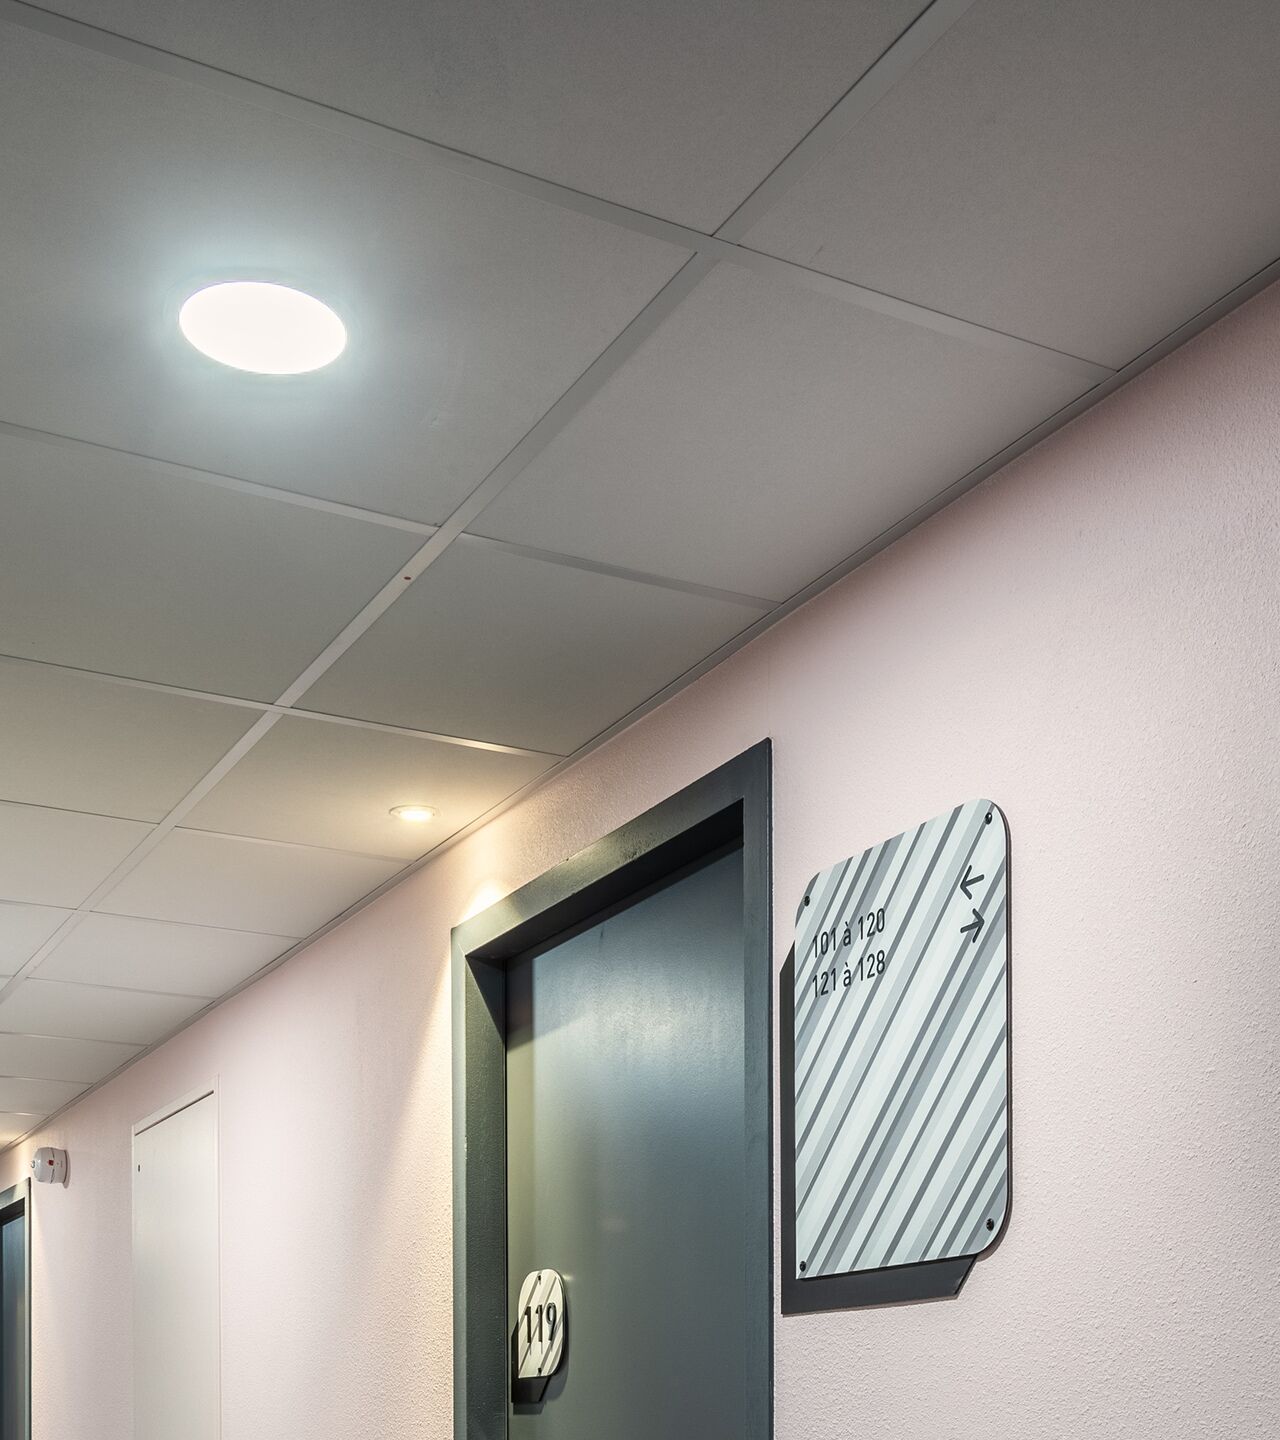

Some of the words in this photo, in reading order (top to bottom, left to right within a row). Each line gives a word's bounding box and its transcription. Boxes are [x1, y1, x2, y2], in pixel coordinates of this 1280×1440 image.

[812, 929, 836, 958] 101
[843, 922, 852, 947] à
[858, 908, 885, 940] 120
[812, 968, 836, 998] 121
[843, 962, 852, 987] à
[858, 950, 885, 981] 128
[525, 1302, 558, 1344] 119
